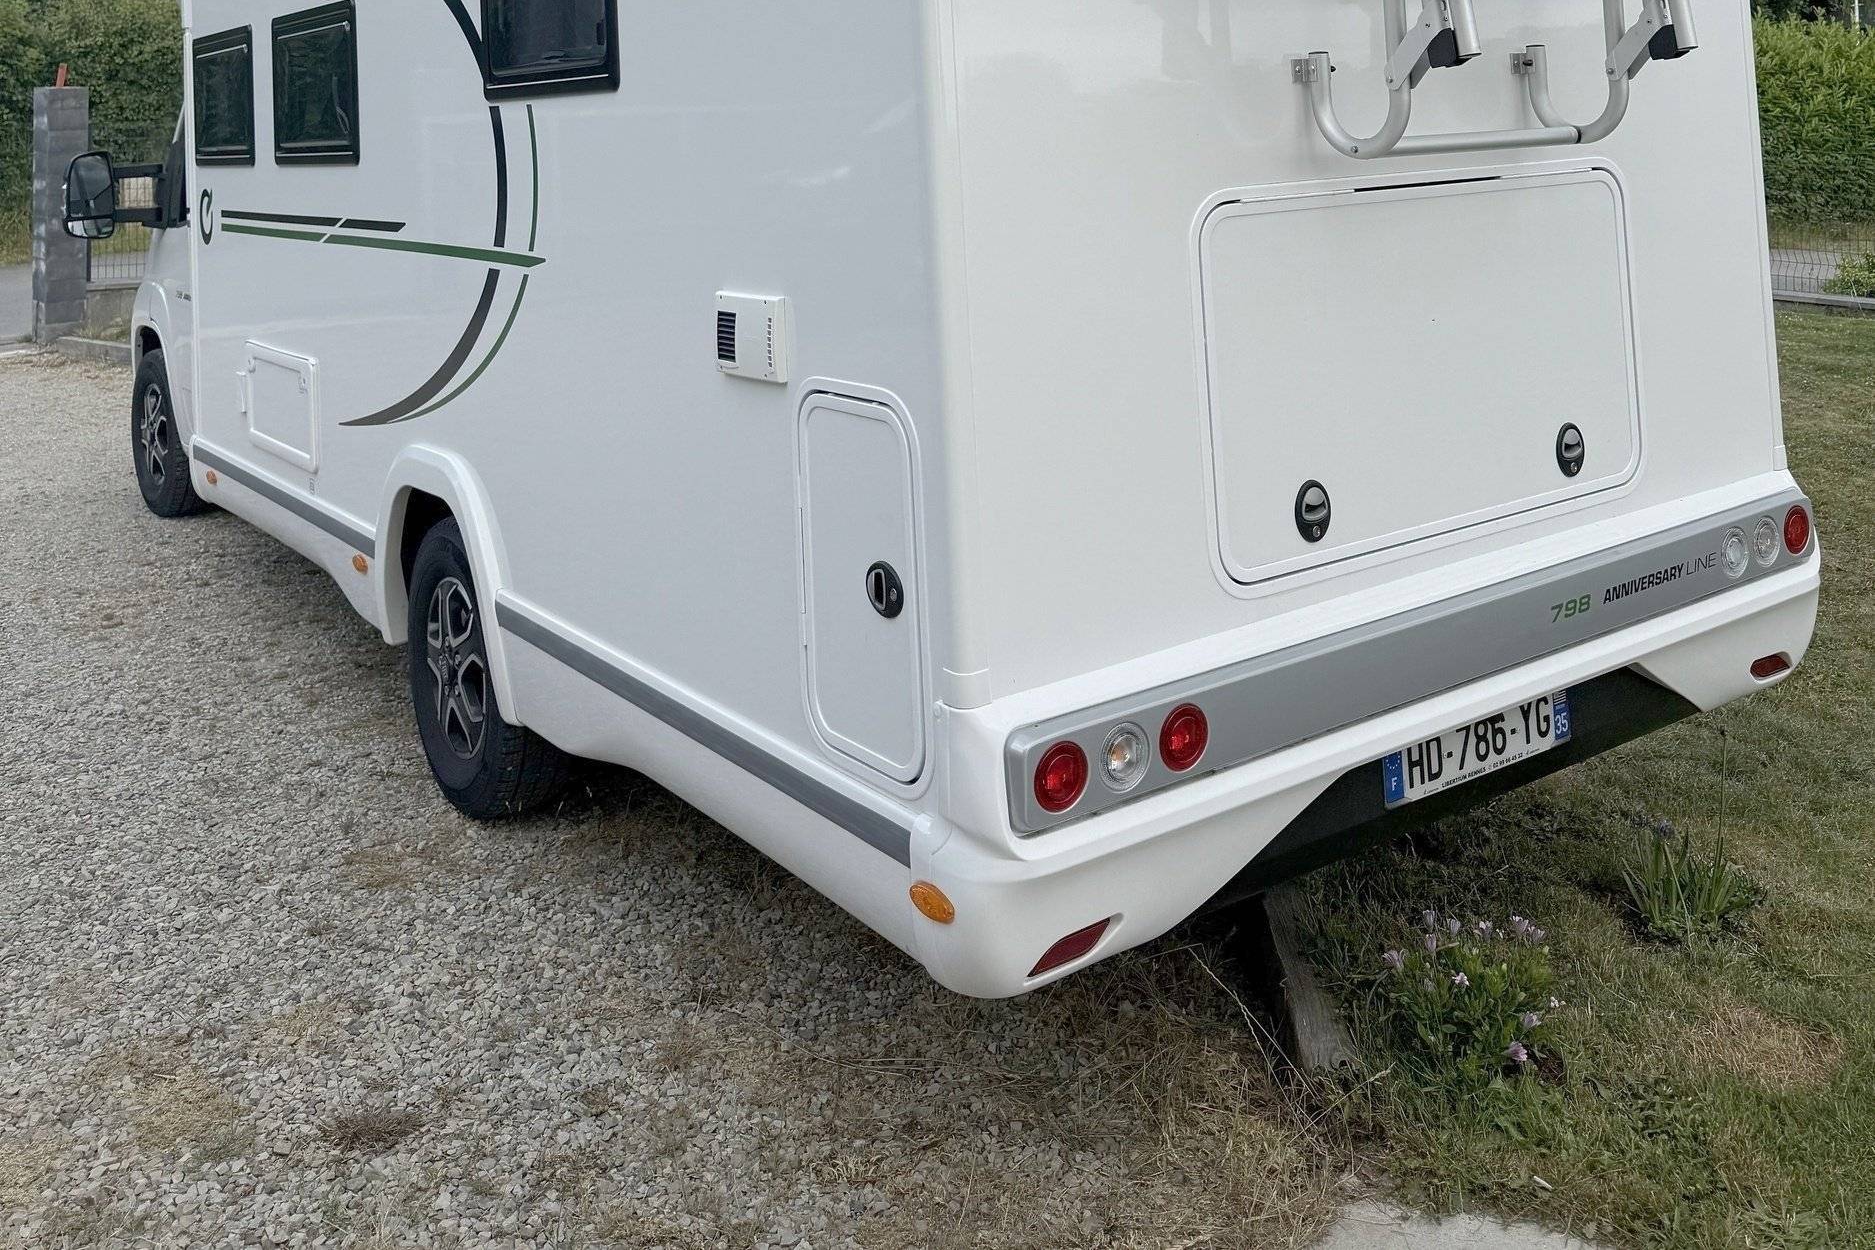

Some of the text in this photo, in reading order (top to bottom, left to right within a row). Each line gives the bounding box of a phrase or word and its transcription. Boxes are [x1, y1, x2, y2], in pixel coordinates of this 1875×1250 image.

[1550, 551, 1718, 623] 798 ANNIVERSARY LINE
[1406, 696, 1551, 789] HD-786-YG
[1555, 712, 1569, 735] 35
[1391, 776, 1398, 792] F
